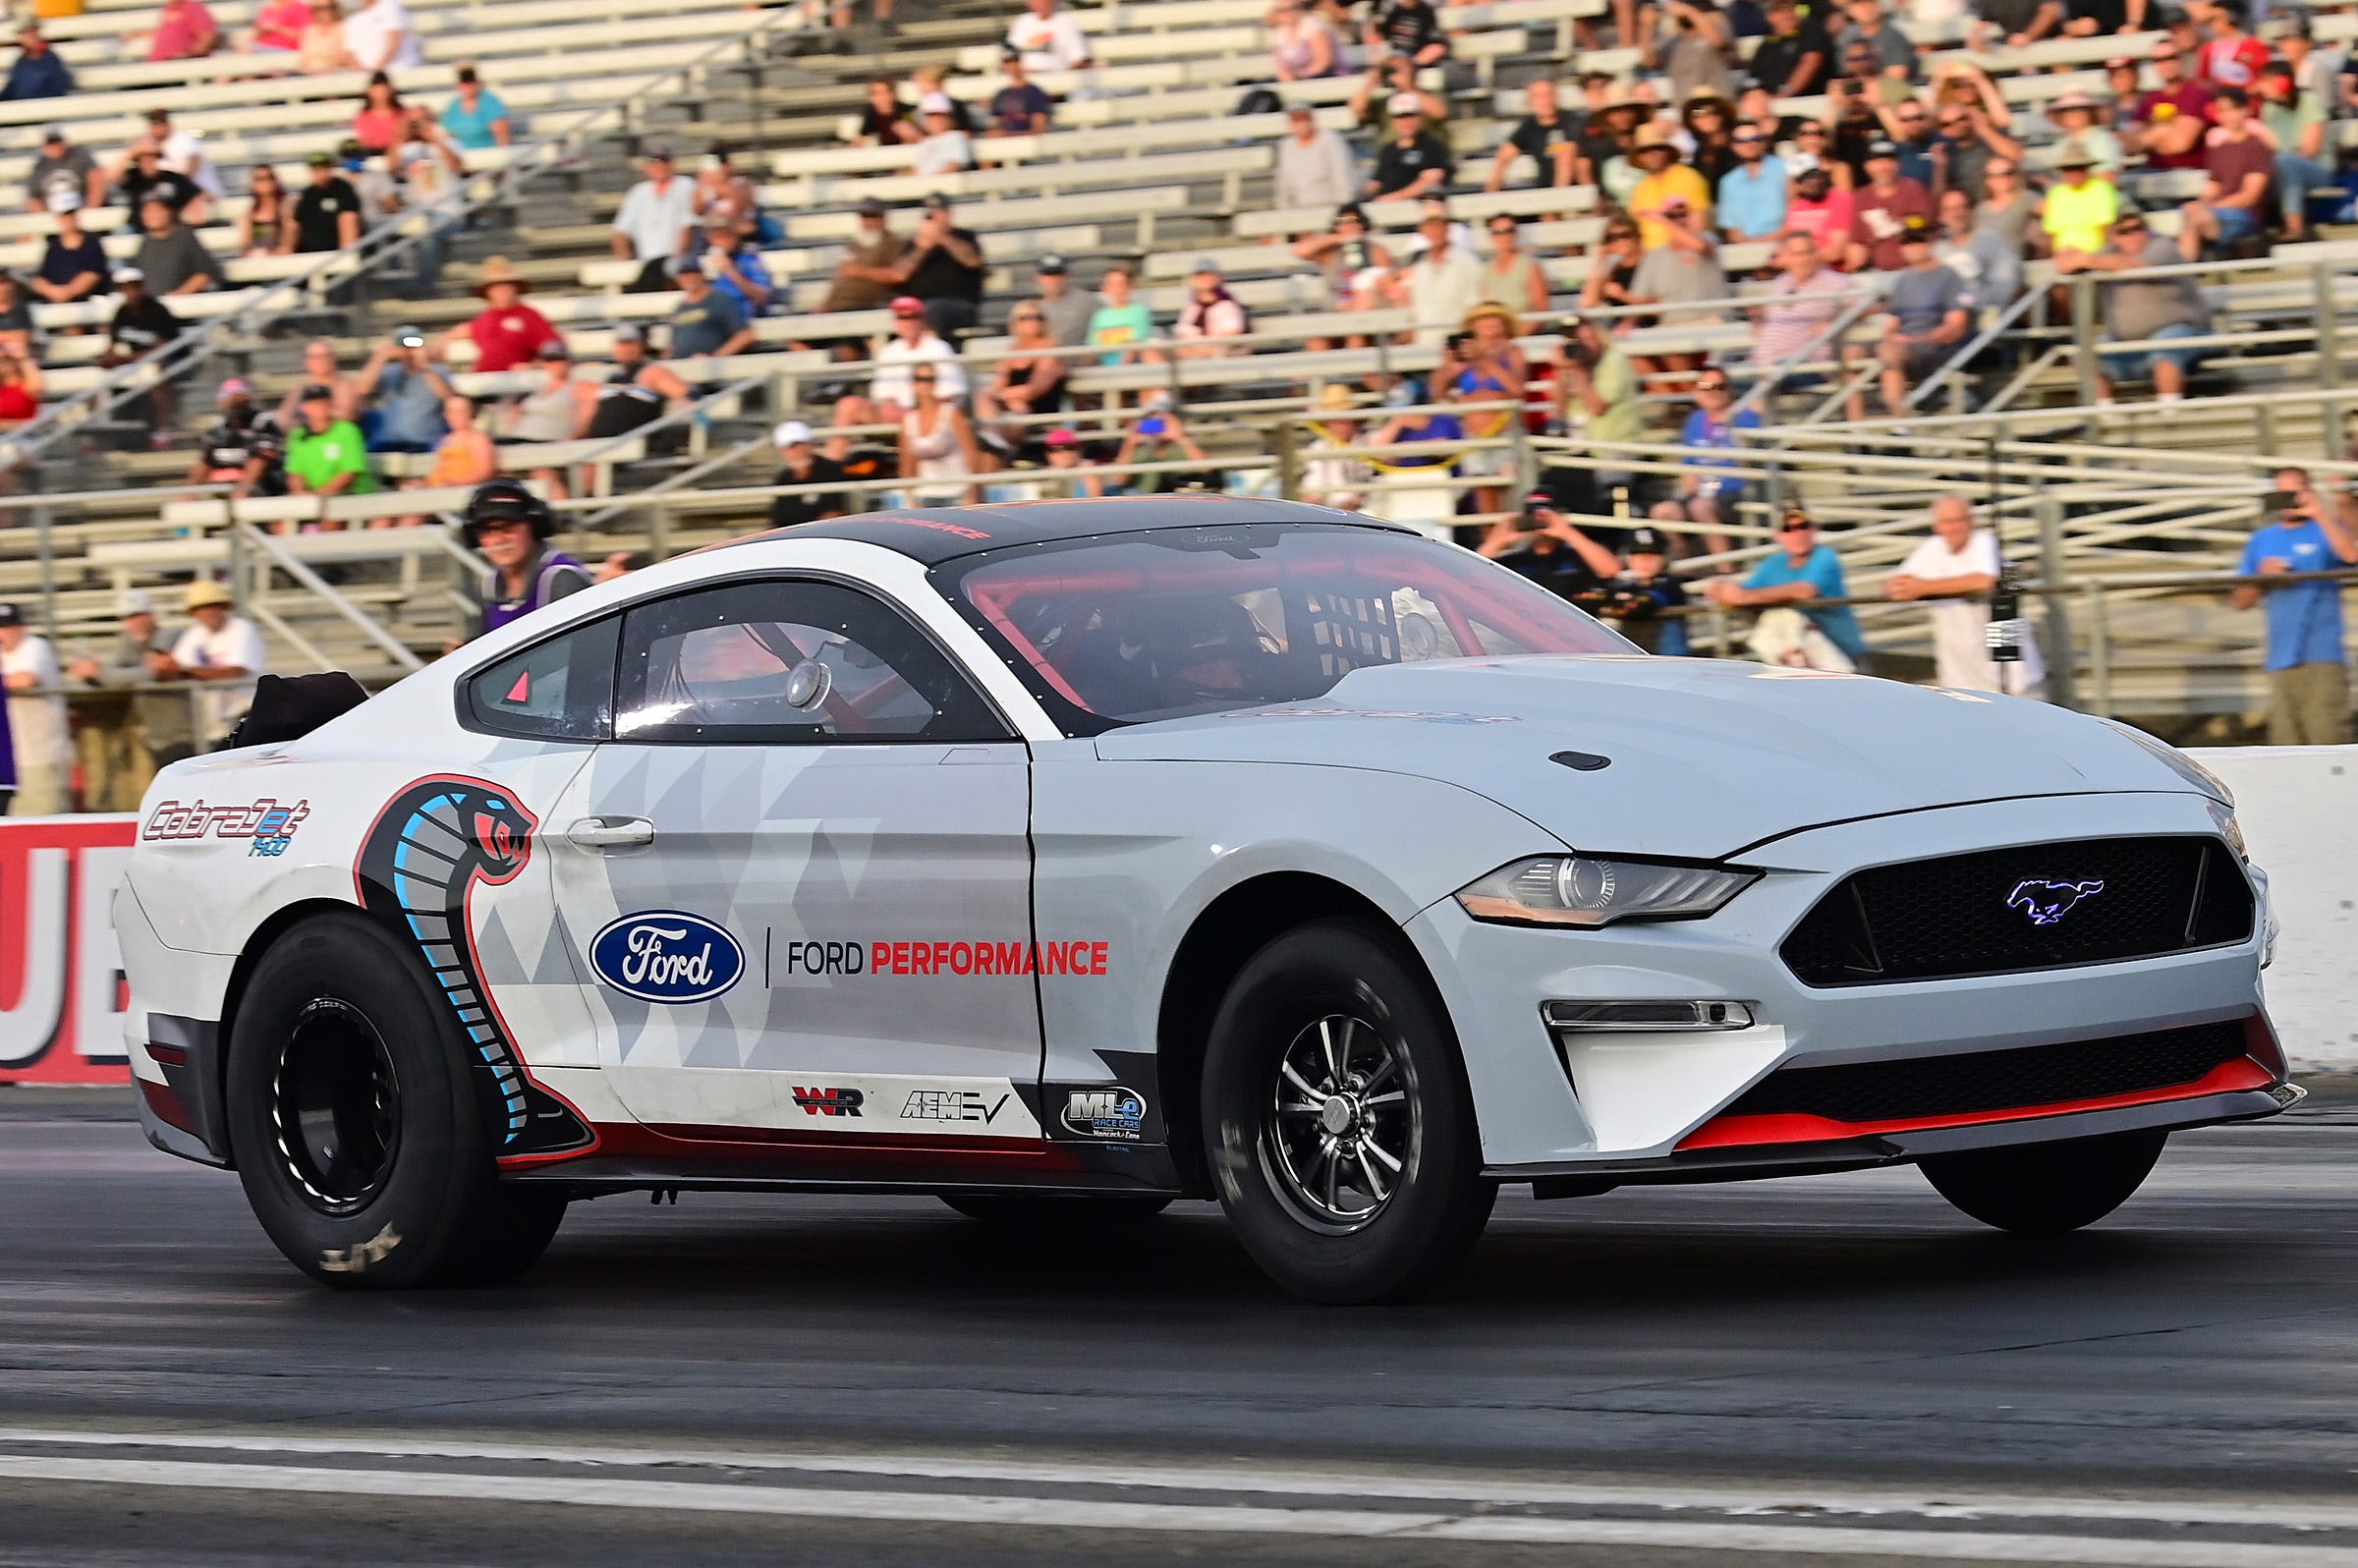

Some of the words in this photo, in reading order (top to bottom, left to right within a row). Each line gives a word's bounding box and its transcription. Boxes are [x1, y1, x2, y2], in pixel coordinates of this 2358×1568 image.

[622, 925, 713, 986] Ford
[788, 941, 864, 975] FORD
[871, 940, 1109, 976] PERFORMANCE
[1094, 1118, 1117, 1127] RACE
[1118, 1119, 1139, 1129] CARS
